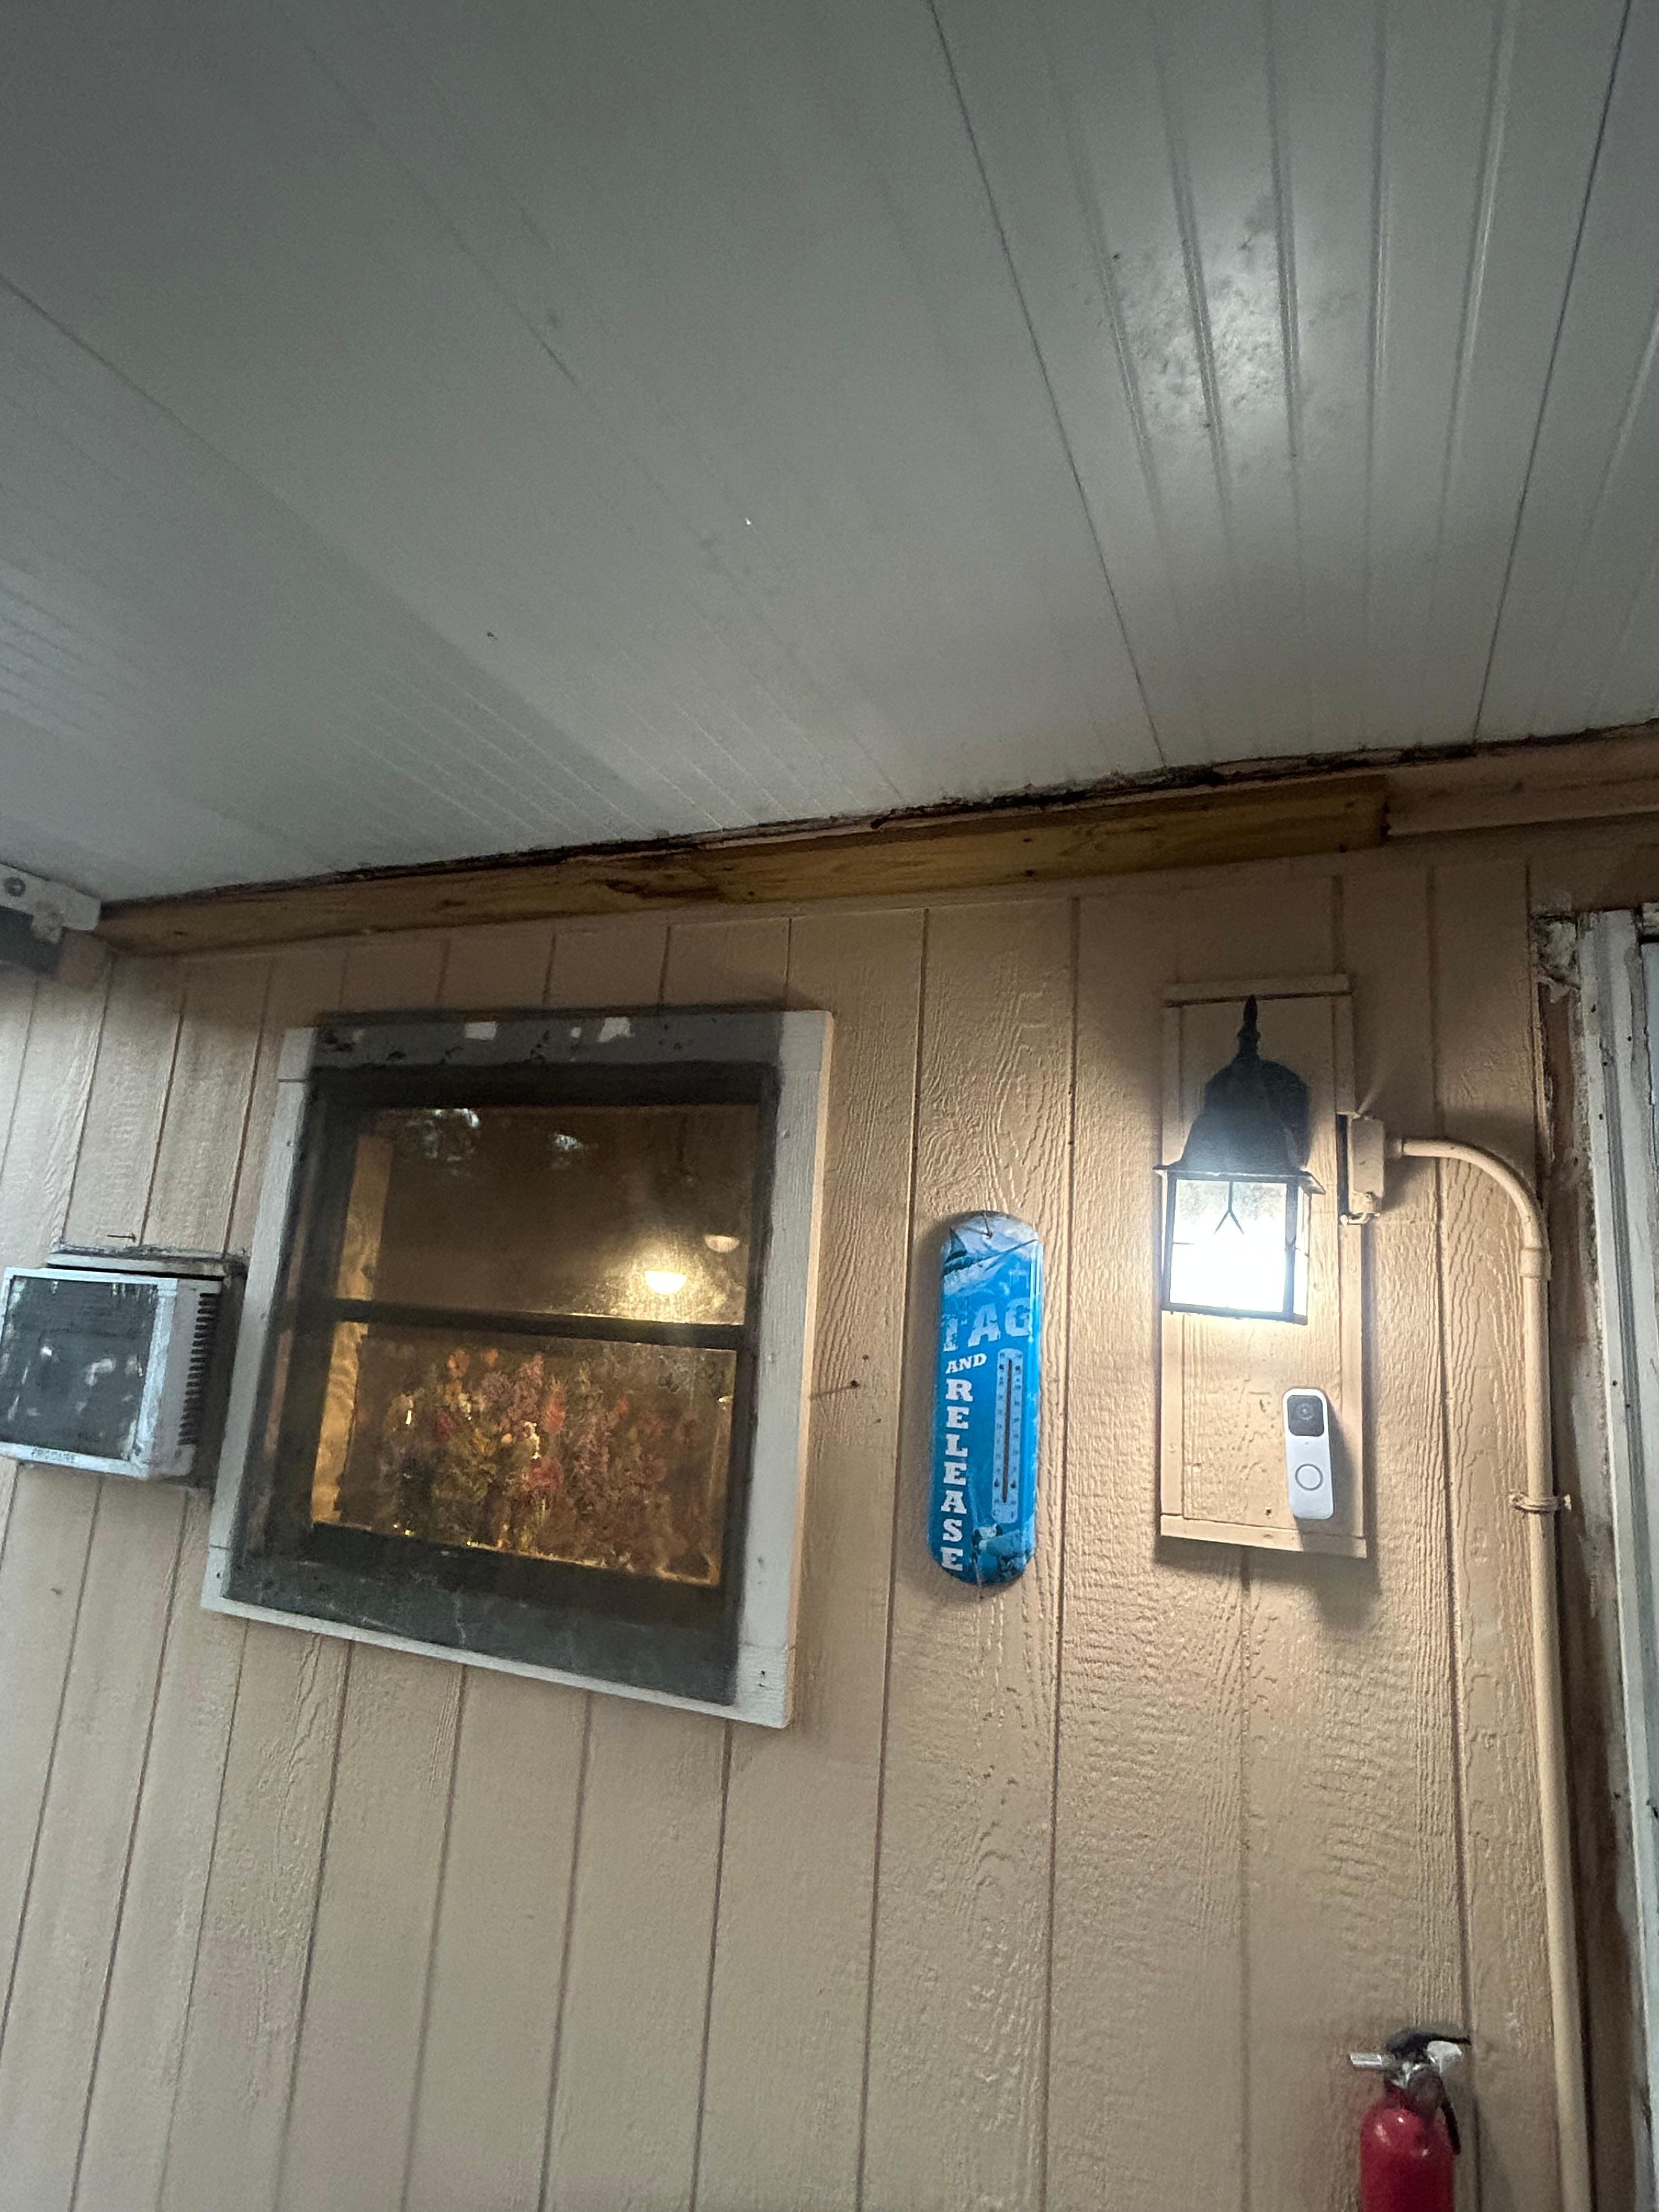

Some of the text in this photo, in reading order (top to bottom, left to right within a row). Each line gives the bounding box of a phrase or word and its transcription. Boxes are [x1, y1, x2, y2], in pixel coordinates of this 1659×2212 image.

[941, 1297, 1032, 1352] TAG
[946, 1353, 987, 1374] AND
[940, 1378, 973, 1571] RELEASE
